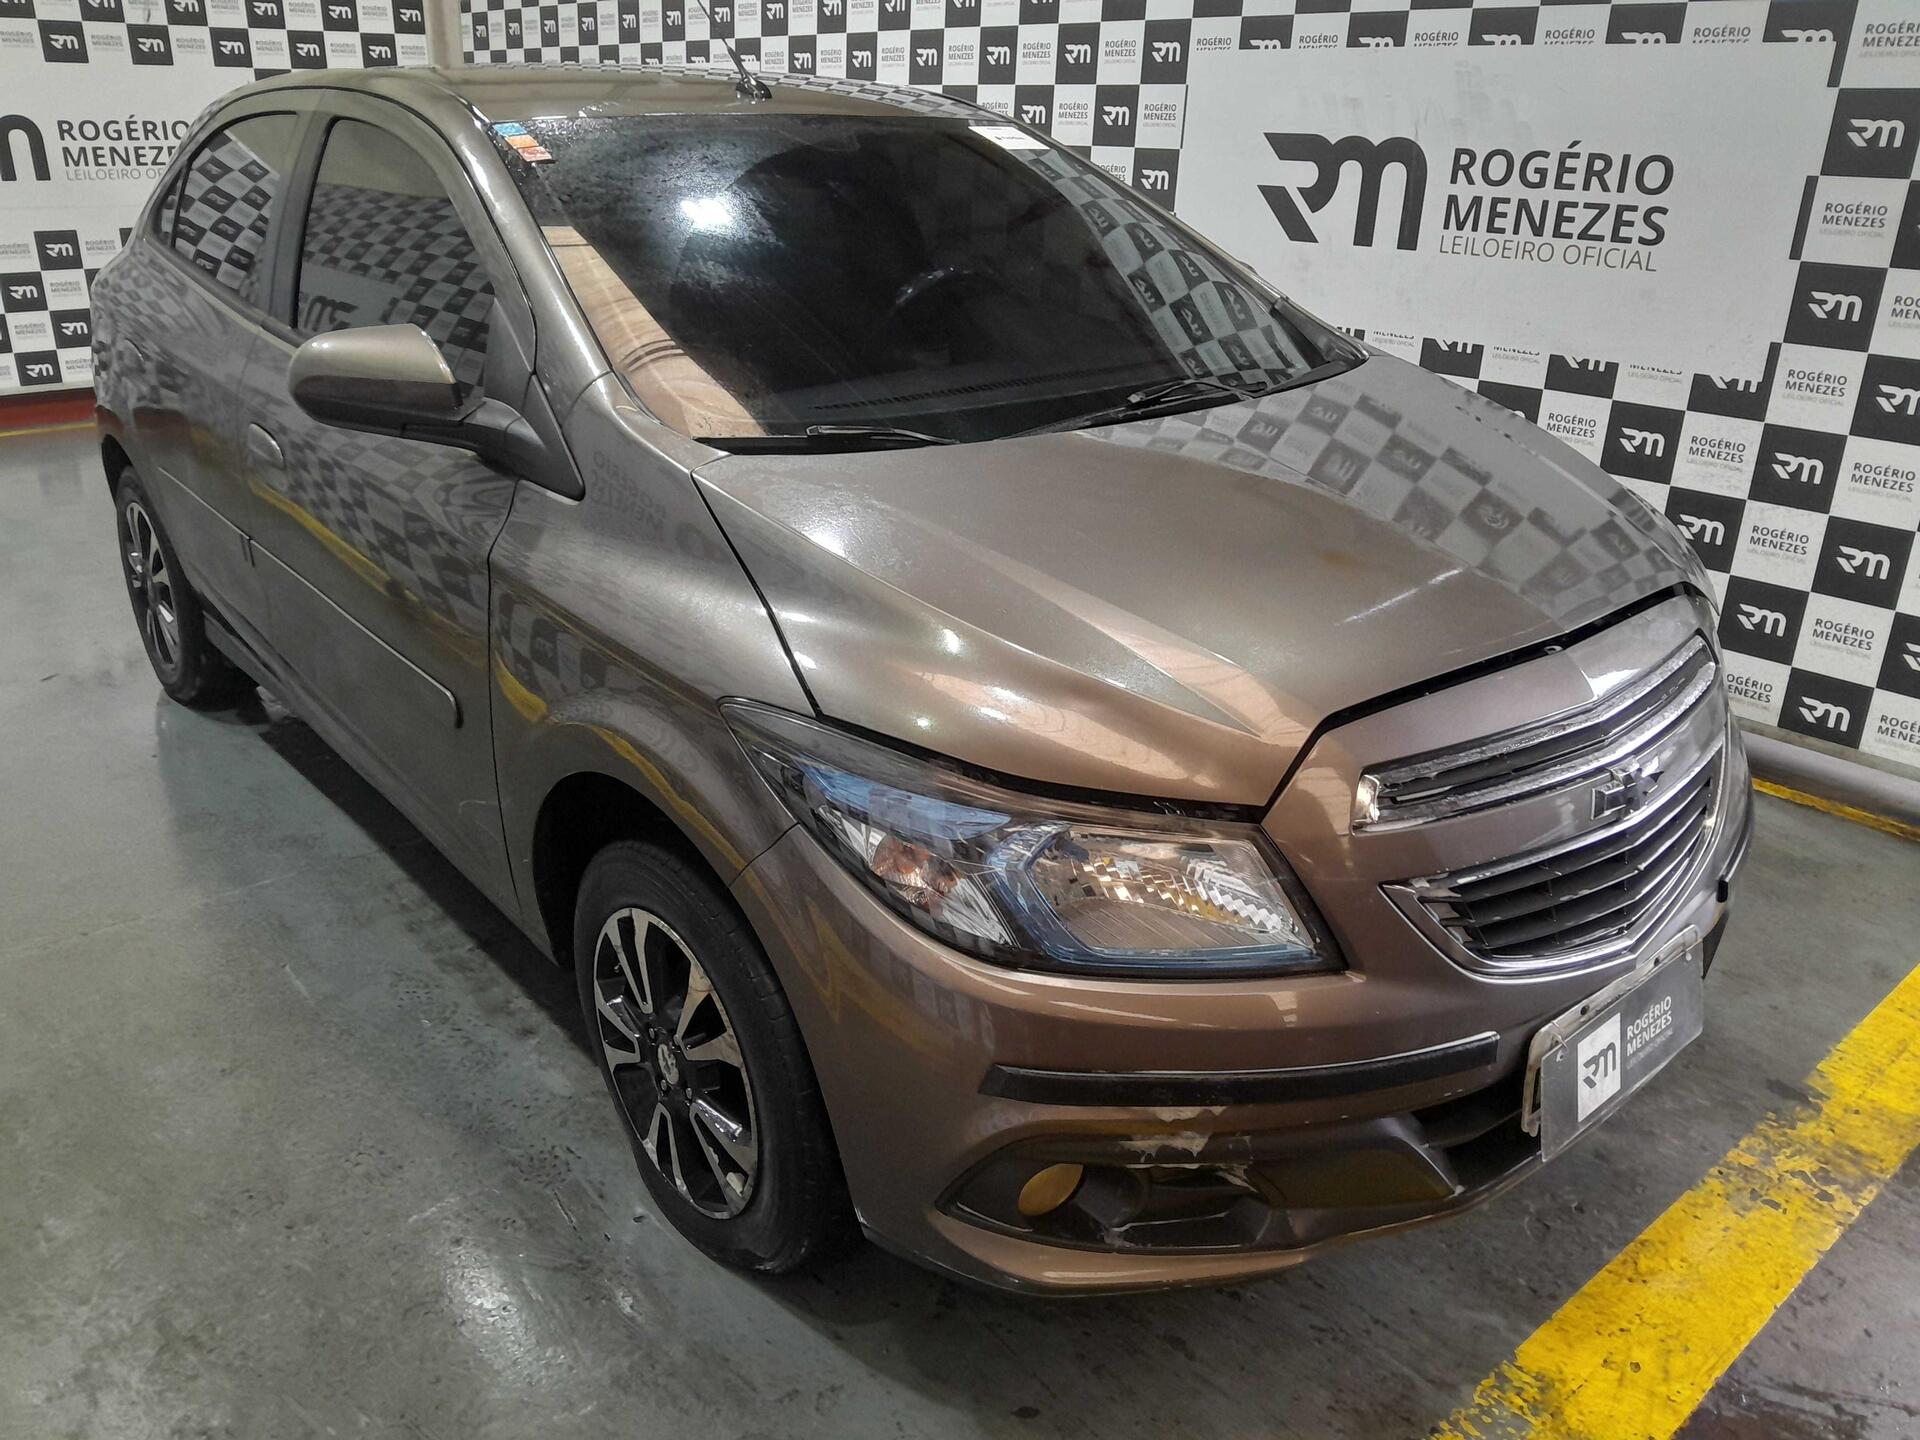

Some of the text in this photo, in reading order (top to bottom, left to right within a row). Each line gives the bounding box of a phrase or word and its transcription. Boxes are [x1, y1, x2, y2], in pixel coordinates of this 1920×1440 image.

[1414, 30, 1459, 41] ROGÉRIO
[1545, 28, 1595, 39] ROGÉRIO
[1693, 26, 1751, 38] ROGÉRIO
[1865, 20, 1920, 34] ROGÉRI
[1022, 41, 1051, 50] ROGÉRIO
[1104, 38, 1137, 48] ROGÉRIO
[1196, 36, 1232, 46] ROGÉRIO
[1299, 33, 1339, 44] ROGÉRIO
[1862, 36, 1920, 47] MENEZE
[1022, 51, 1051, 59] MENEZES
[1104, 49, 1136, 57] MENEZES
[1059, 102, 1089, 110] ROGÉRIO
[1144, 102, 1177, 111] ROGÉRIO
[1143, 113, 1177, 121] MENEZES
[1847, 119, 1906, 148] RM
[62, 146, 176, 167] MENEZ
[65, 168, 142, 181] LEILOEIRO
[1100, 164, 1127, 173] OGÉRIO
[1450, 140, 1675, 196] ROGÉRIO
[1256, 132, 1428, 251] RM
[1824, 202, 1888, 216] ROGÉRIO
[1442, 194, 1669, 246] MENEZES
[1821, 215, 1886, 228] MENEZES
[1439, 235, 1657, 272] LEILOEIRO OFICIAL
[1807, 291, 1863, 322] RM
[1787, 369, 1848, 385] ROGÉRIO
[1785, 380, 1846, 397] MENEZES
[1548, 411, 1597, 428] ROGÉRIO
[1546, 423, 1595, 438] MENEZES
[1619, 427, 1665, 457] RM
[1690, 436, 1746, 452] ROGÉRIO
[1688, 446, 1744, 464] MENEZES
[1771, 452, 1824, 485] RM
[1853, 462, 1916, 481] ROGÉRIO
[1850, 473, 1914, 493] MENEZES
[1752, 525, 1809, 544] ROGÉRIO
[1749, 535, 1808, 555] MENEZES
[1836, 545, 1891, 580] RM
[1736, 603, 1787, 637] RM
[1814, 618, 1875, 640] ROGÉRIO
[1812, 628, 1873, 651] MENEZES
[1726, 673, 1773, 693] OGÉRIO
[1727, 684, 1772, 703] ENEZES
[1798, 696, 1851, 732] RM
[1880, 714, 1920, 733] ROGÉ
[1627, 996, 1672, 1040] ROGÉRIO
[1627, 1010, 1672, 1057] MENEZES
